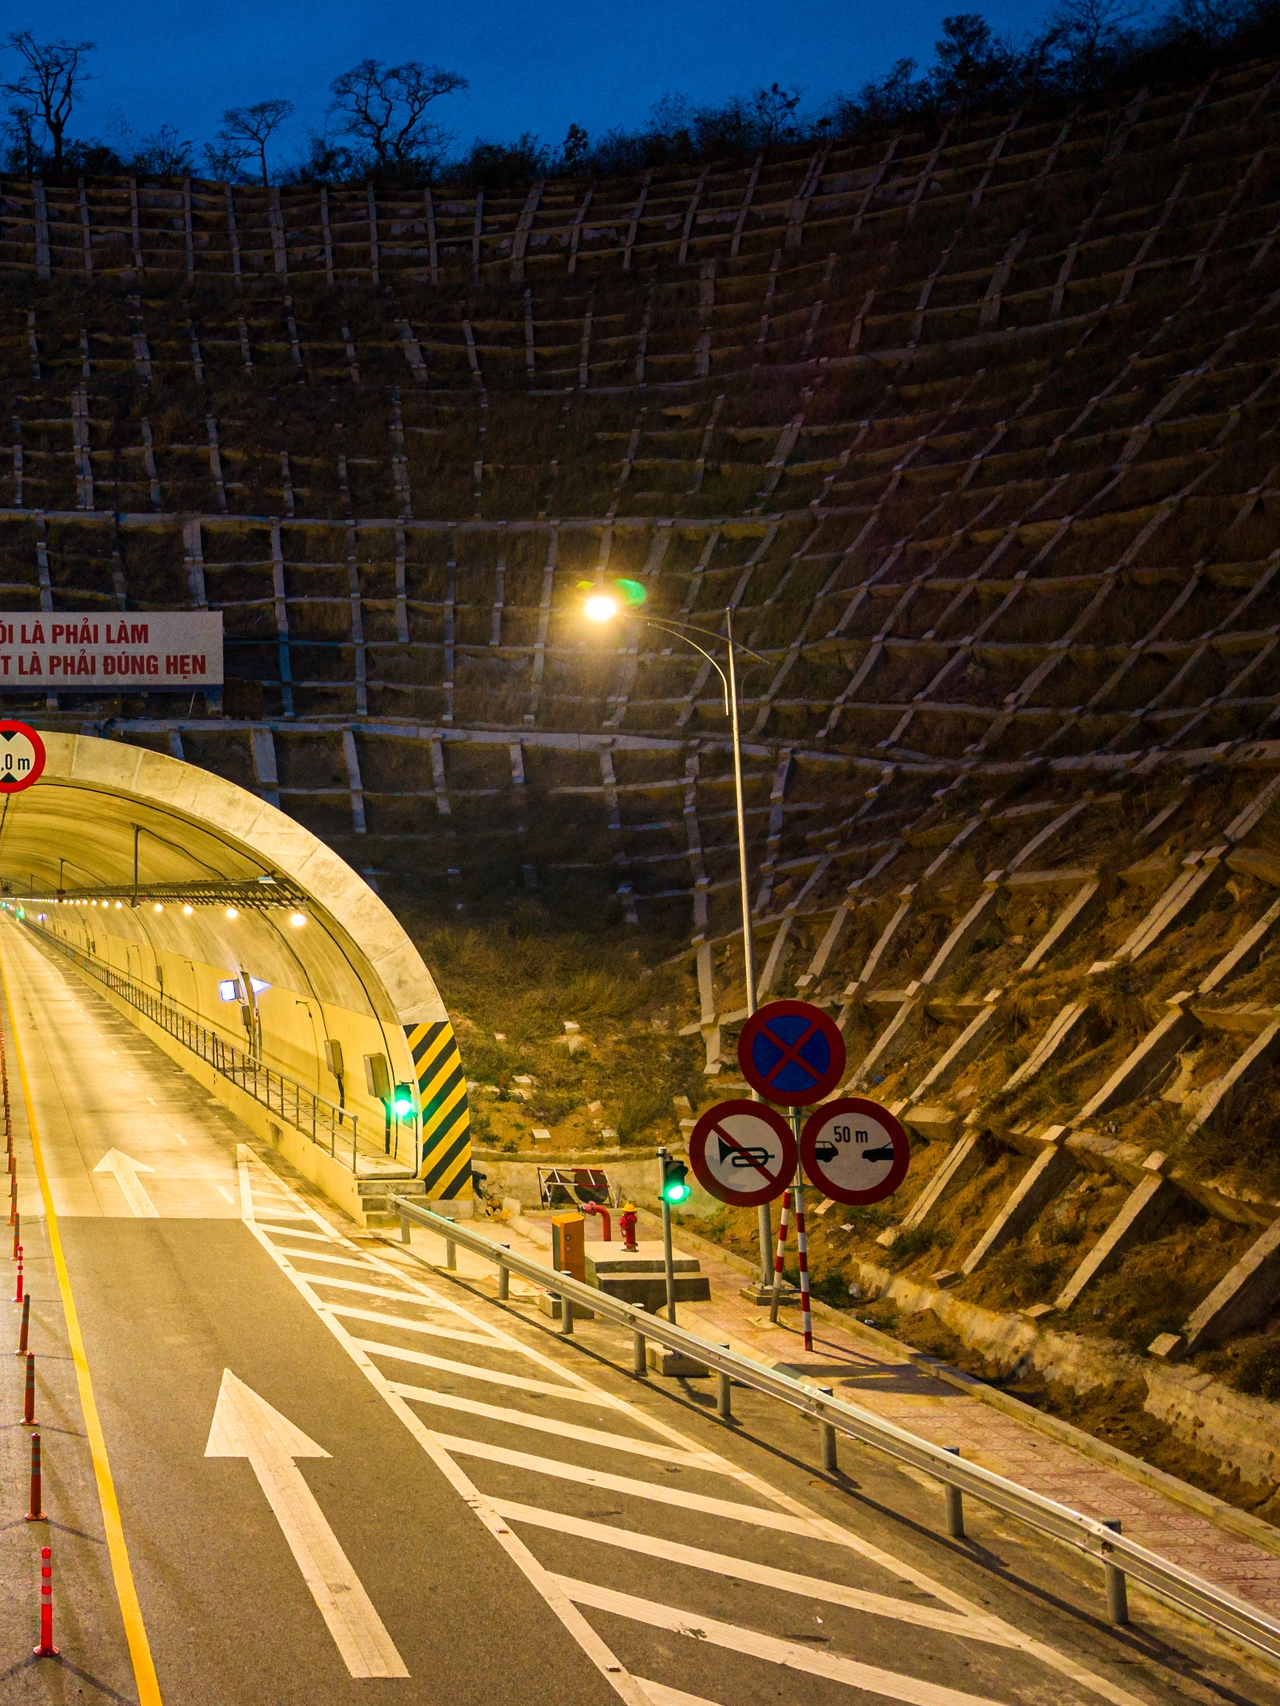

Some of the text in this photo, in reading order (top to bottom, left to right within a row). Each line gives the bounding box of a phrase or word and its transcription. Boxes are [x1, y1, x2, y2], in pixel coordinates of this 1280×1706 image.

[21, 619, 45, 644] LÀ
[52, 617, 99, 644] PHẢI
[106, 619, 149, 644] LÀM
[18, 651, 43, 676] LÀ
[49, 648, 96, 676] PHẢI
[102, 651, 159, 676] ĐÚNG
[166, 655, 206, 679] HẸN
[17, 757, 30, 771] m
[833, 1125, 869, 1143] 50 m
